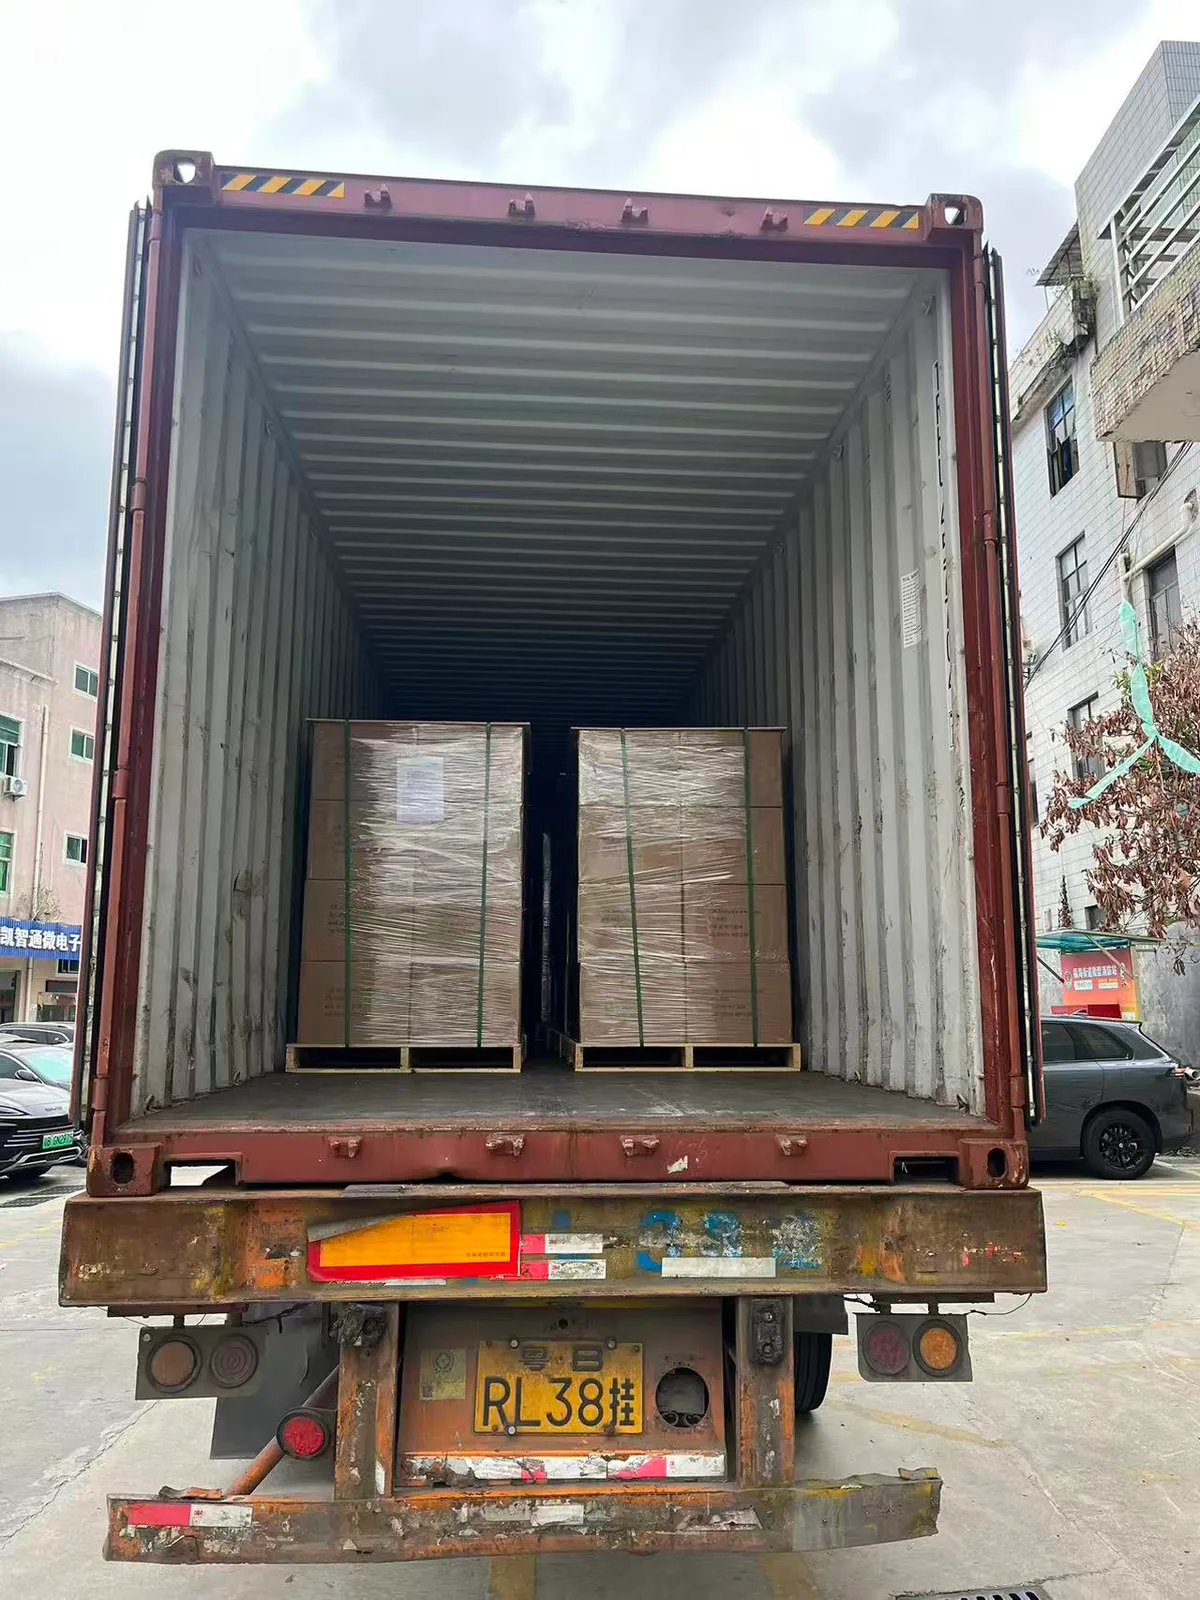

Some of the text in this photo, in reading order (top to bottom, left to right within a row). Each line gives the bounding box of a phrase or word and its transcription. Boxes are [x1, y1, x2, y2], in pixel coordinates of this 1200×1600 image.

[0, 926, 81, 952] 凯智通微电子
[482, 1376, 635, 1428] RL38挂
